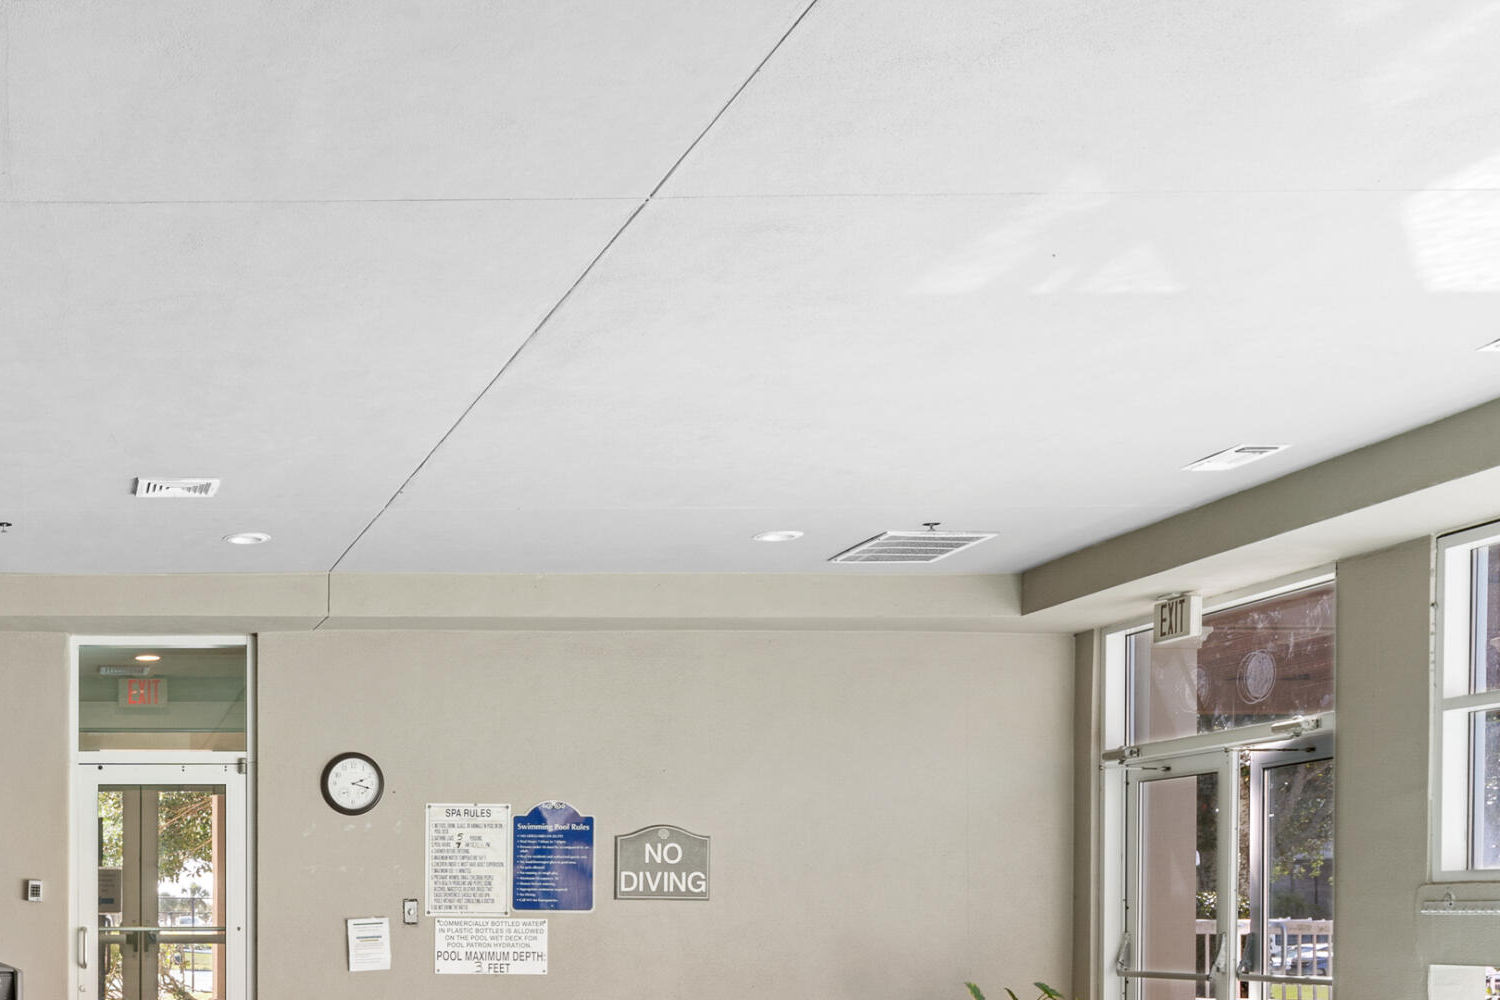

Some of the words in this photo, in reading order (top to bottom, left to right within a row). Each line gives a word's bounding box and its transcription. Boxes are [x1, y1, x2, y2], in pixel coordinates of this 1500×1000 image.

[1160, 599, 1185, 637] EXIT
[128, 679, 160, 705] EXIT
[445, 808, 462, 818] SPA
[463, 808, 492, 818] RULES
[517, 822, 554, 832] Swimming
[554, 823, 570, 831] Pool
[571, 823, 590, 831] Rules
[644, 842, 683, 864] NO
[620, 871, 706, 893] DIVING
[436, 950, 462, 961] POOL
[465, 950, 510, 962] MAXIMUM
[487, 963, 511, 973] FEET
